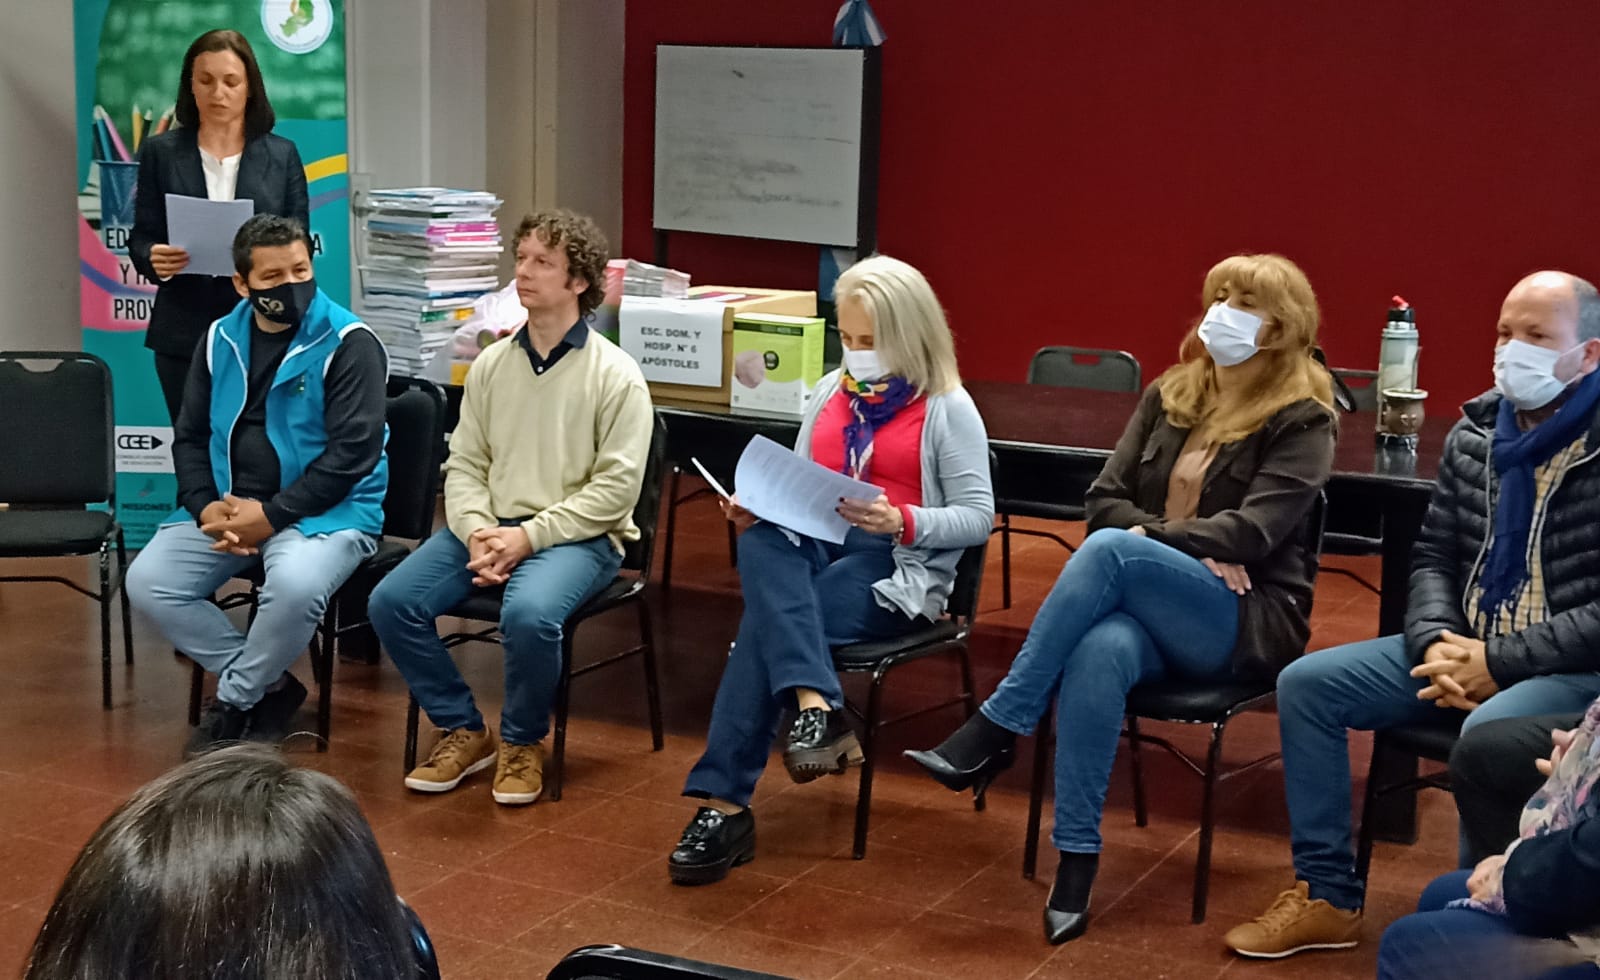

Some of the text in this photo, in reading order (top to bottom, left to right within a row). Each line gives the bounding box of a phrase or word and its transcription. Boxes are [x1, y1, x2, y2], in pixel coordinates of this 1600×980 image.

[665, 328, 691, 339] DOM.
[694, 330, 702, 339] Y
[644, 341, 674, 351] HOSP.
[690, 344, 697, 353] 6
